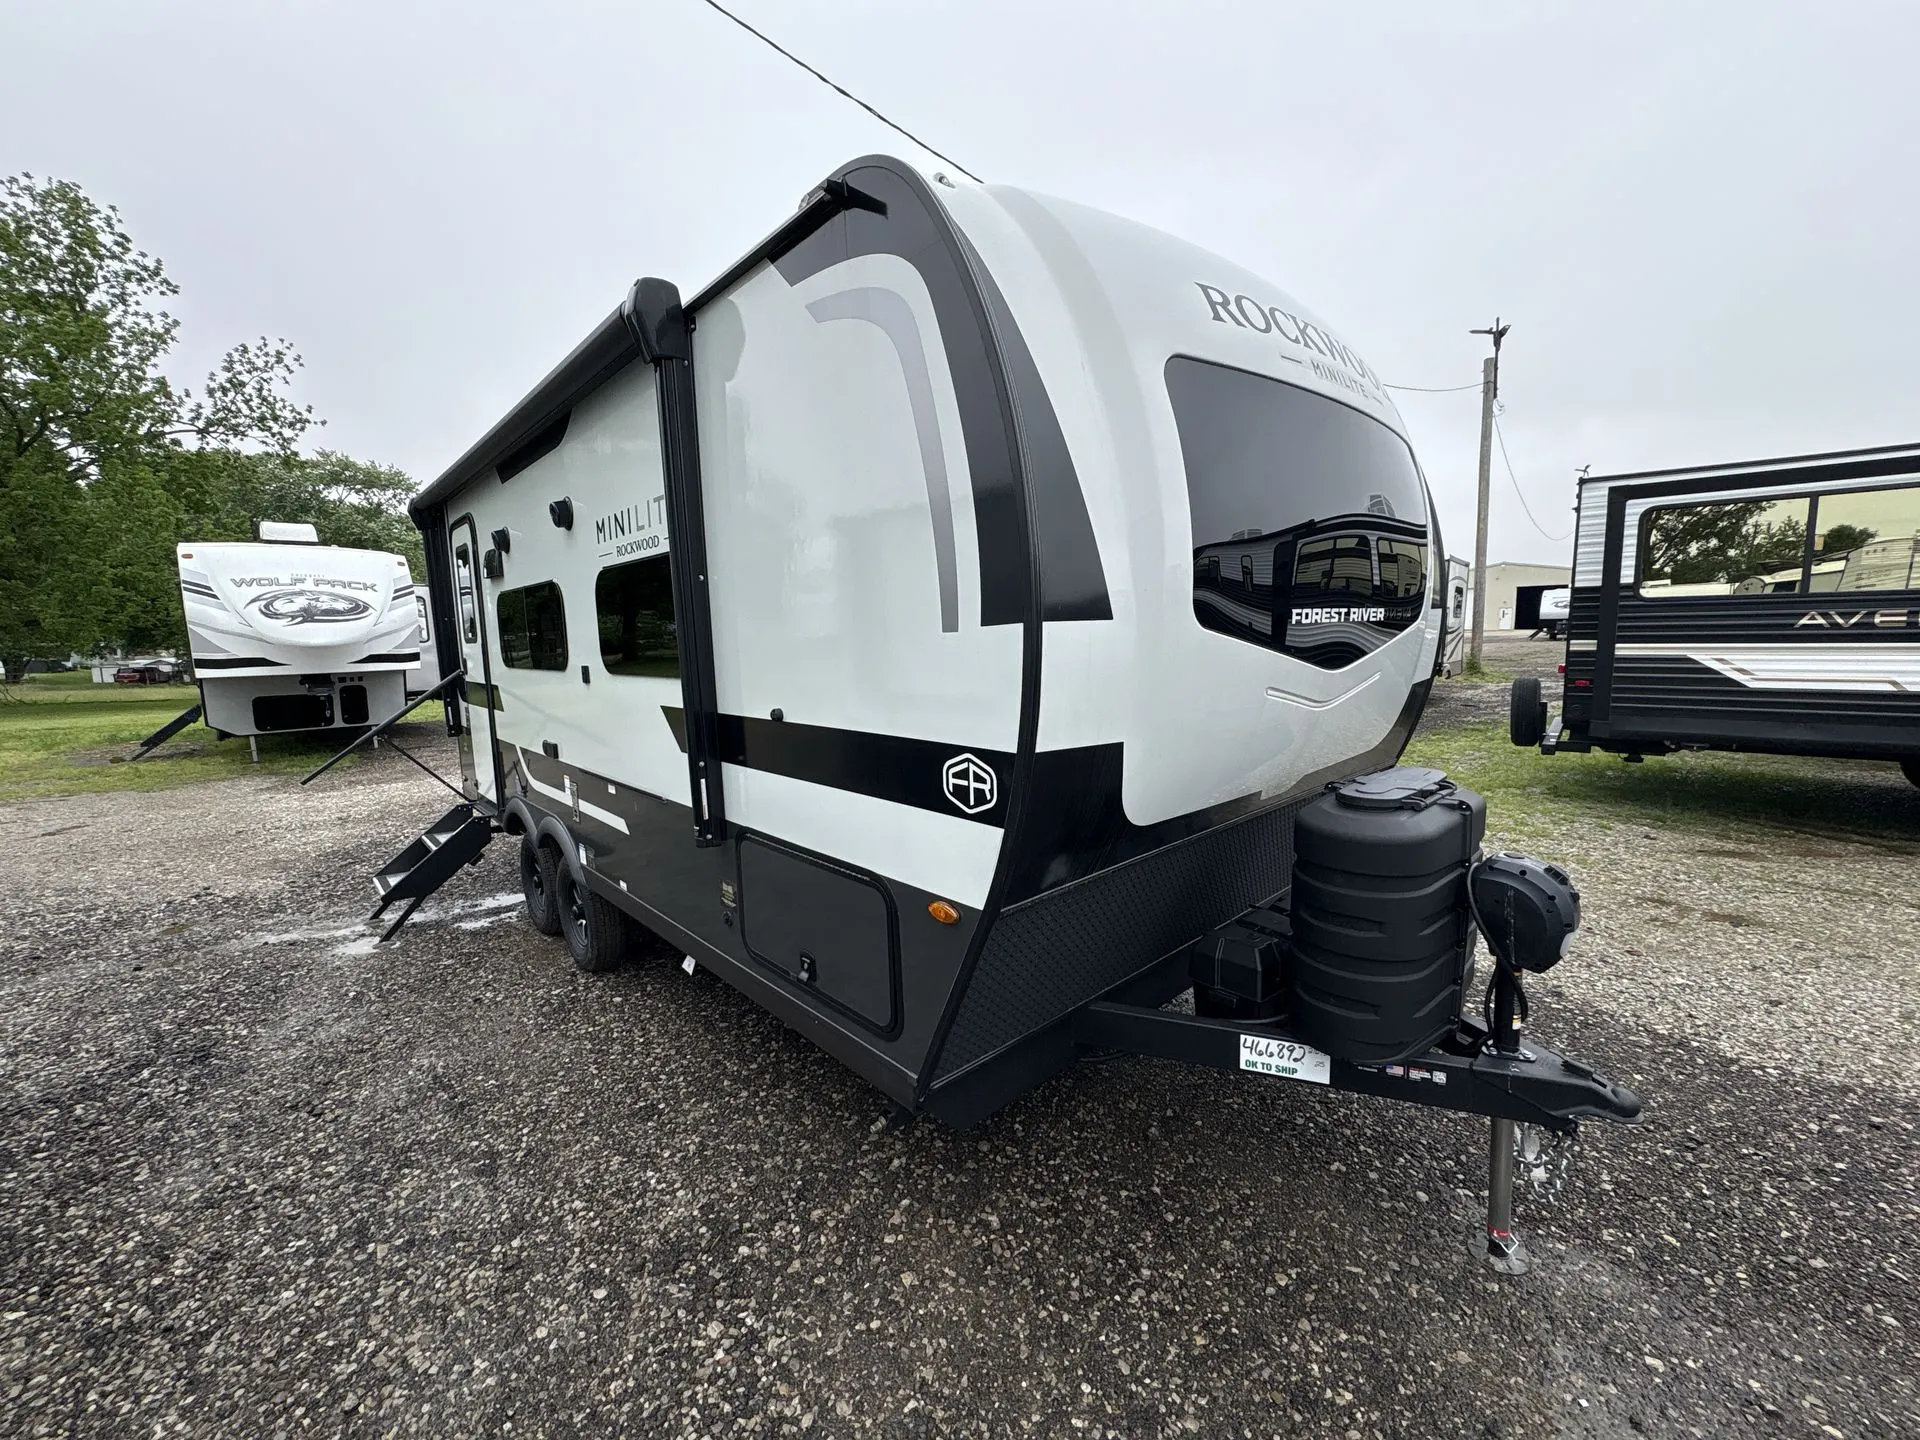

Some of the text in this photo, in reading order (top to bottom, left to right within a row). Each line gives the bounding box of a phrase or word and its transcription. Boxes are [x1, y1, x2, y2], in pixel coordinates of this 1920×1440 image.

[1310, 358, 1370, 399] MINILITE
[595, 494, 666, 545] MINILIT
[615, 534, 661, 558] ROCKWOOD
[229, 576, 307, 588] WOLF
[312, 577, 379, 593] PACK
[1291, 607, 1348, 625] FOREST
[1349, 607, 1386, 623] RIVER
[1793, 609, 1920, 629] AVE
[1242, 1036, 1307, 1064] 466892
[1244, 1059, 1299, 1076] OK TO SHIP
